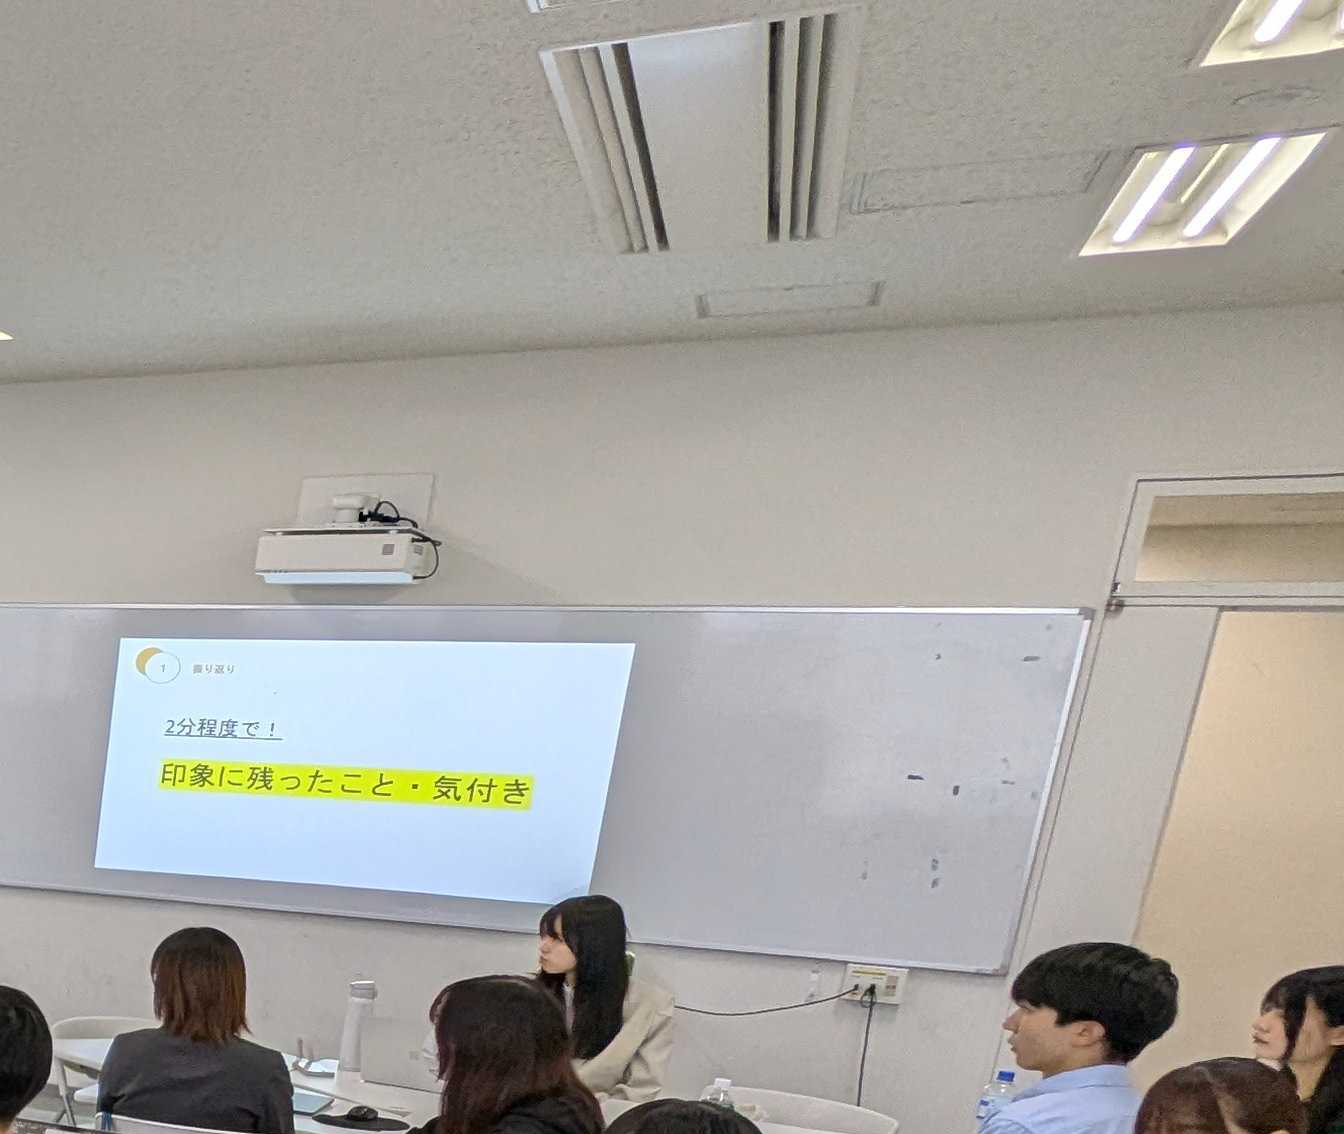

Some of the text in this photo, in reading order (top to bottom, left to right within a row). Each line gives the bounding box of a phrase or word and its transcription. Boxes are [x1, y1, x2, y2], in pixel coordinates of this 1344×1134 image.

[160, 762, 531, 804] 印象に残ったこと・気付き
